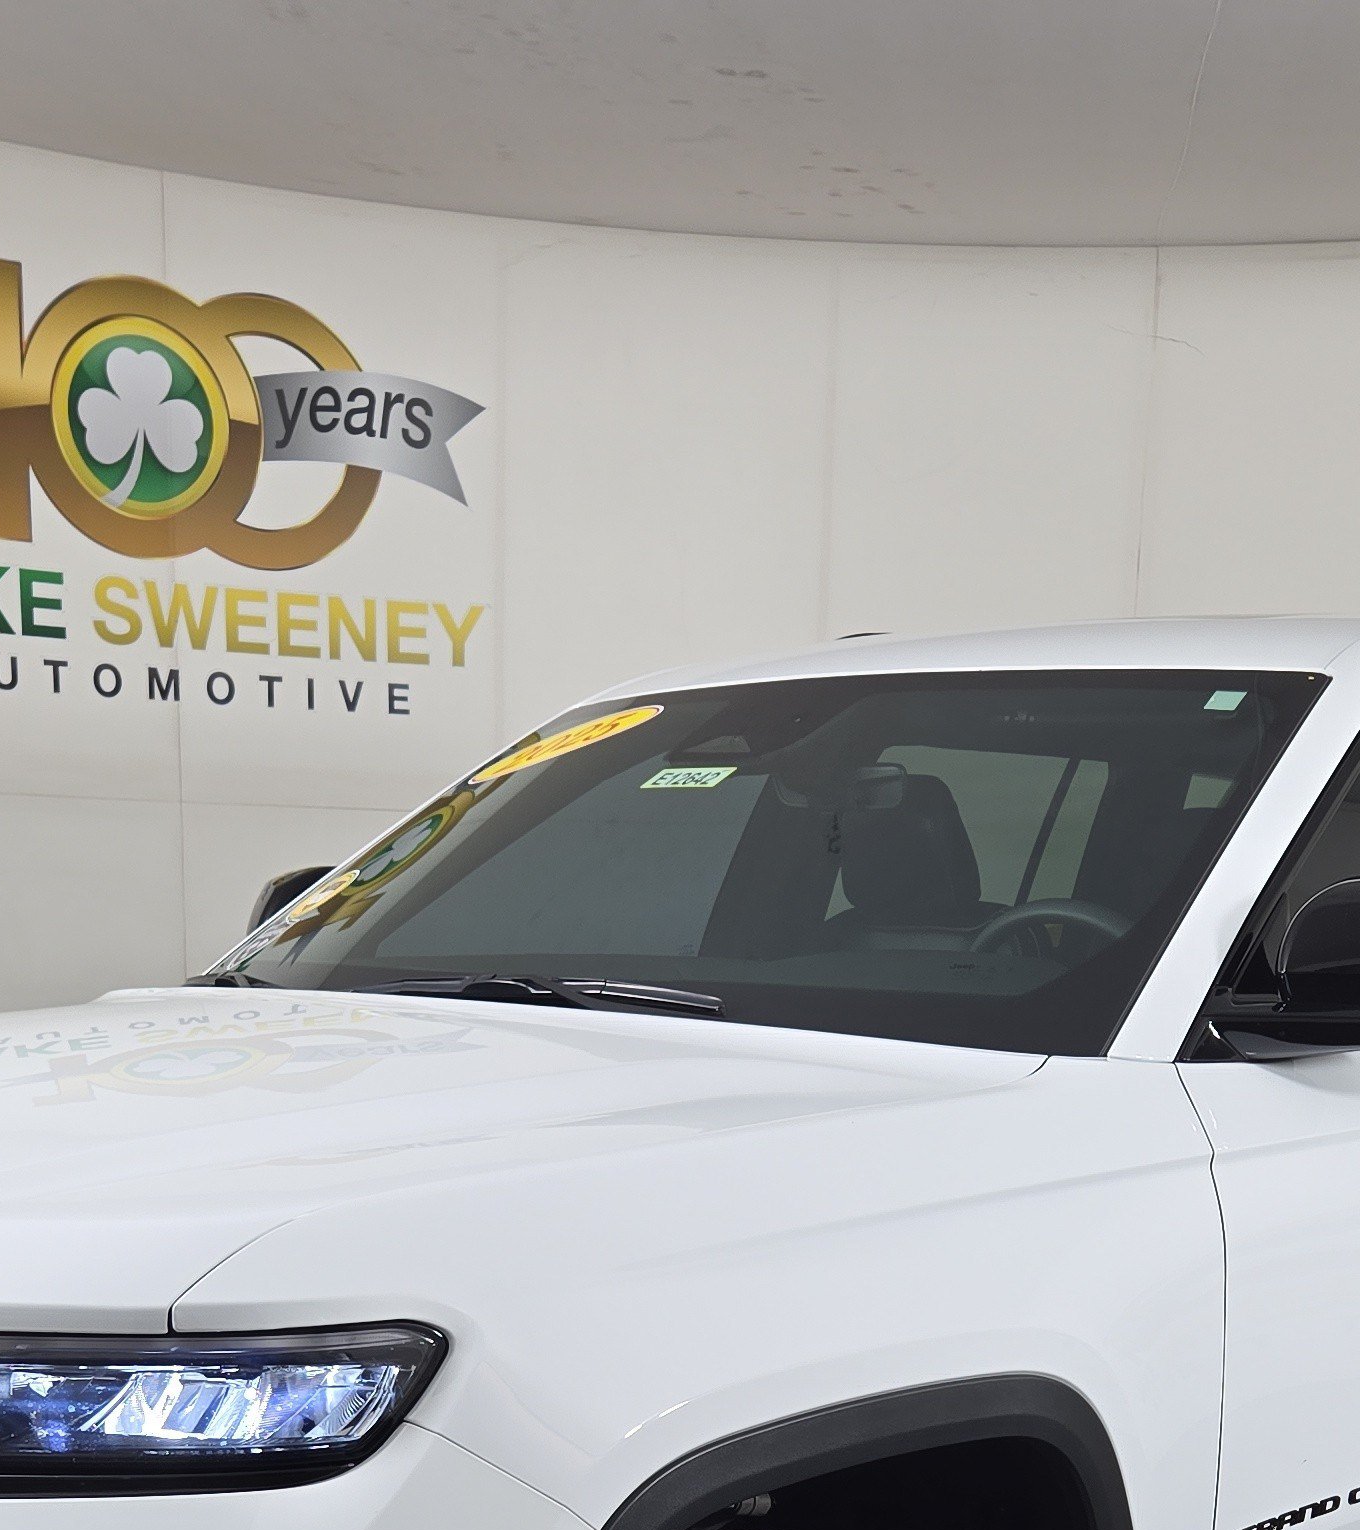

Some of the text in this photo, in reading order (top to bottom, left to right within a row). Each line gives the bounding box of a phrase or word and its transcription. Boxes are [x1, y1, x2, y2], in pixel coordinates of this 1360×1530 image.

[274, 384, 434, 450] years
[92, 574, 485, 668] SWEENEY
[651, 771, 722, 786] E12642
